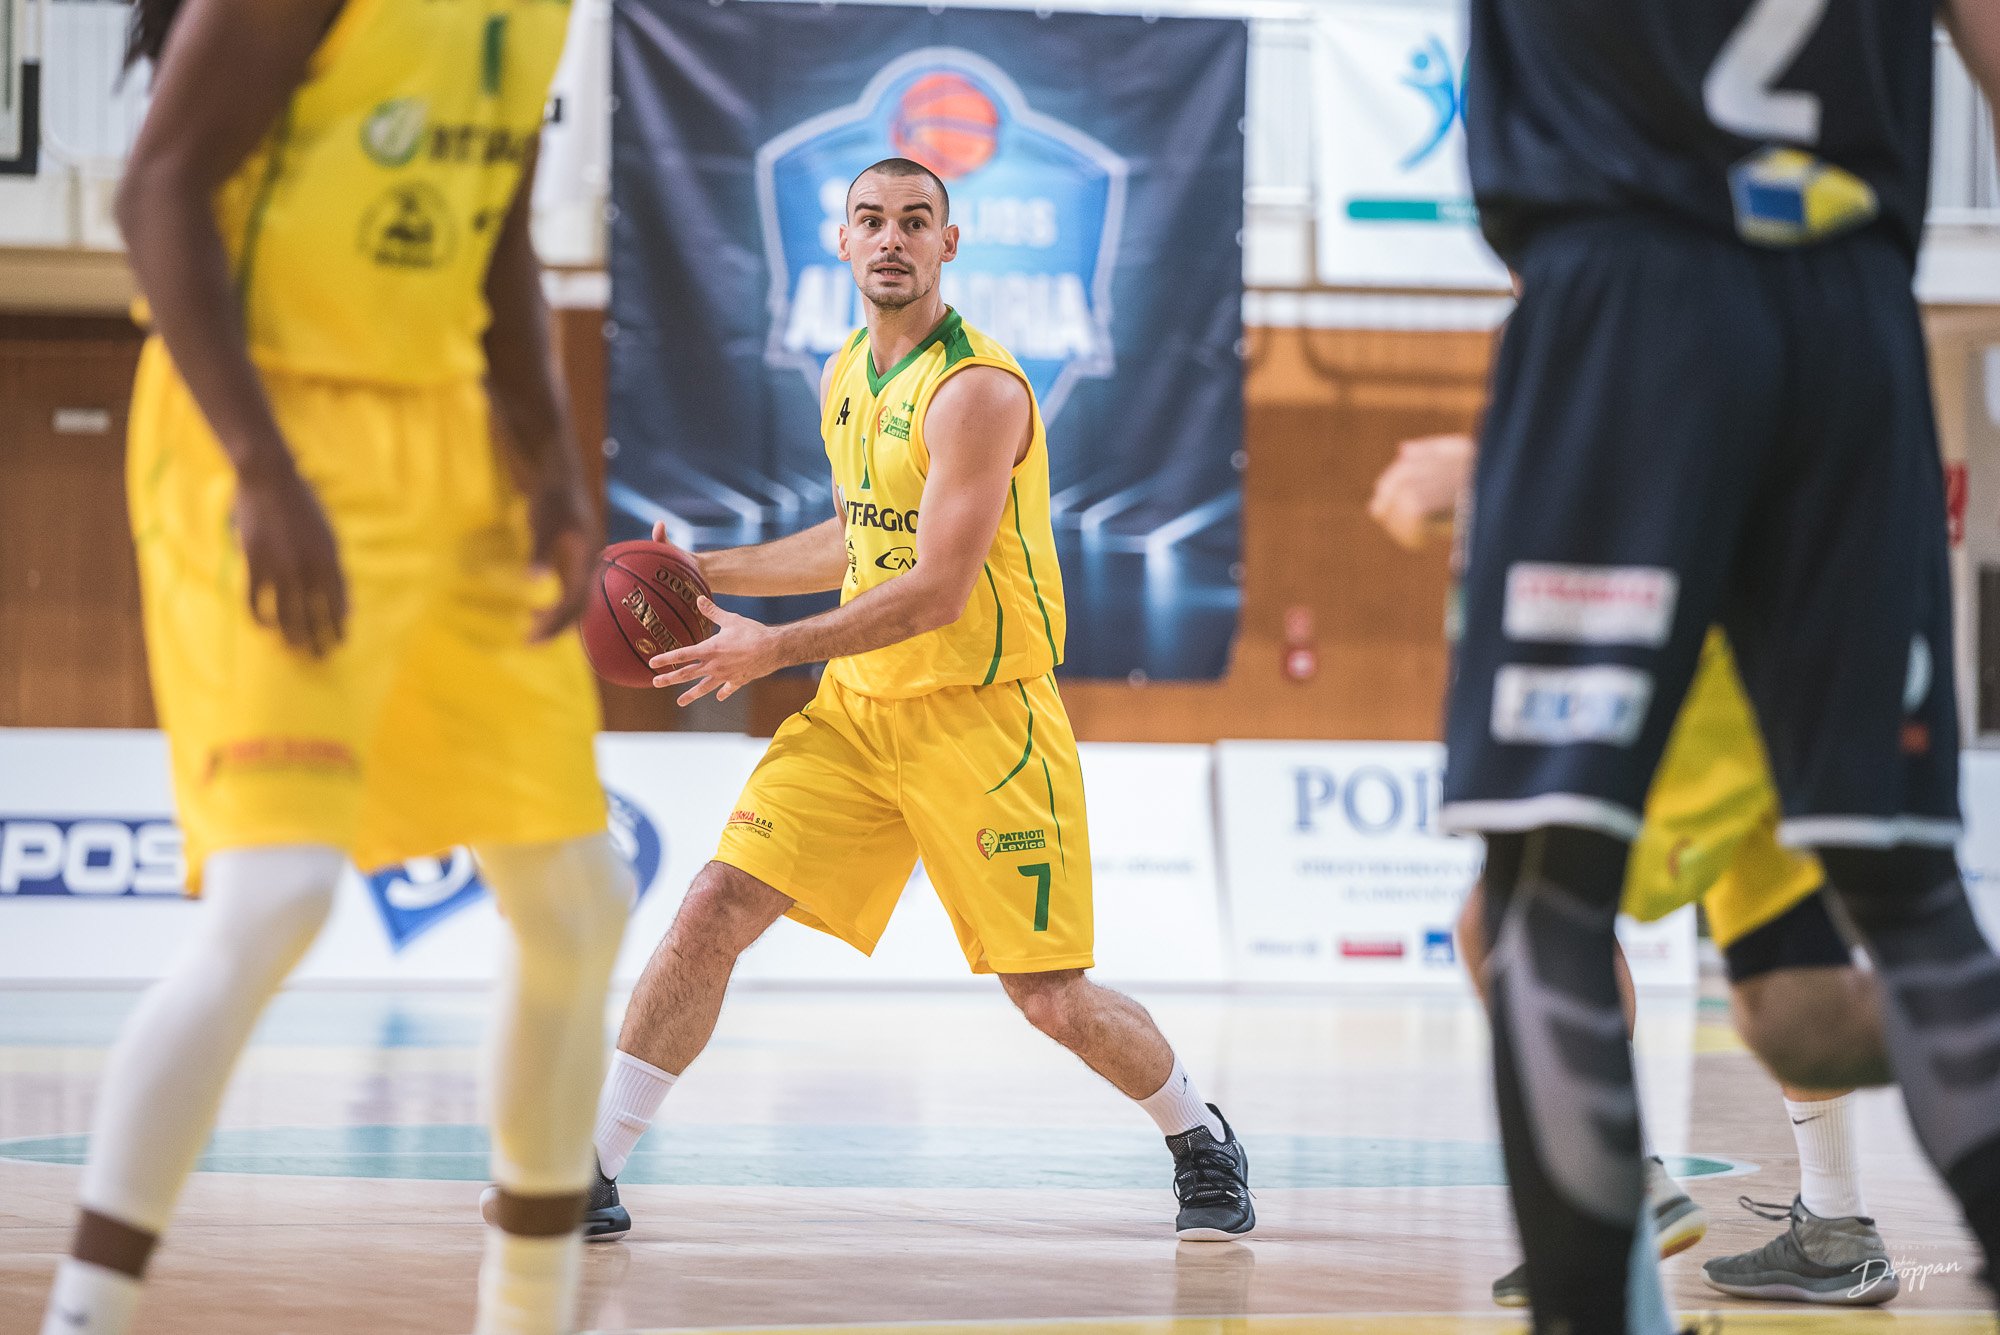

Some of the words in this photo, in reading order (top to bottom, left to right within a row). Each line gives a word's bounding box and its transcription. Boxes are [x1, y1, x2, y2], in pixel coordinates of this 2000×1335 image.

[999, 829, 1045, 843] PATRIOTI
[1000, 840, 1046, 853] Levice
[1017, 863, 1051, 931] 7
